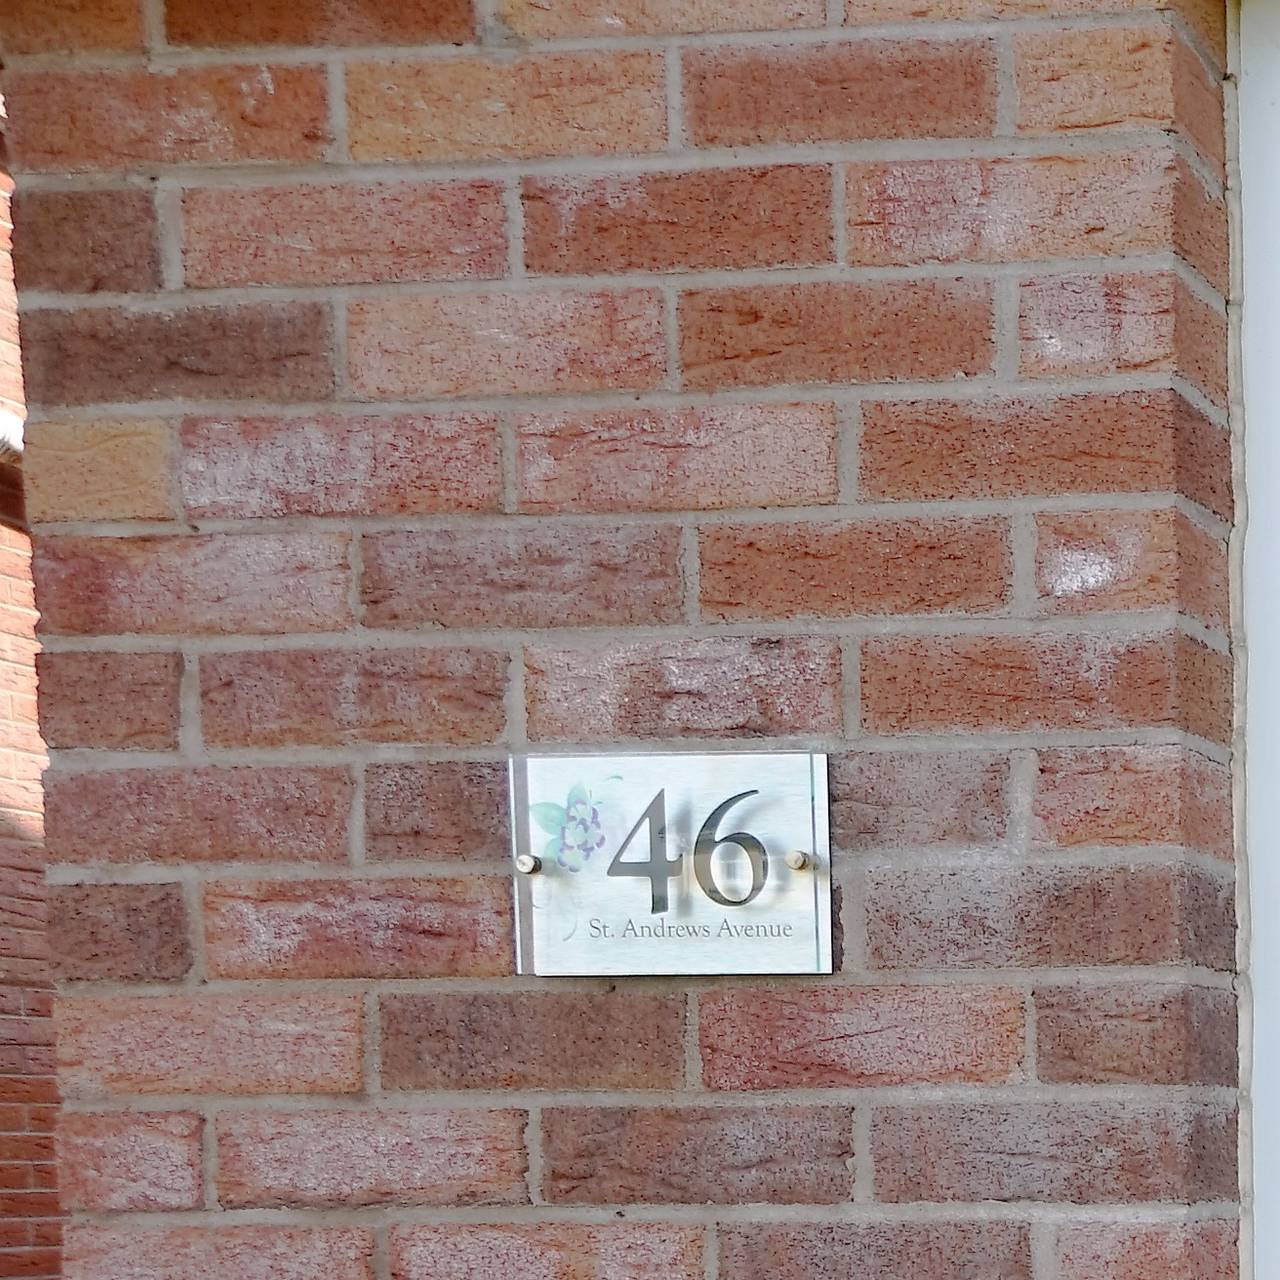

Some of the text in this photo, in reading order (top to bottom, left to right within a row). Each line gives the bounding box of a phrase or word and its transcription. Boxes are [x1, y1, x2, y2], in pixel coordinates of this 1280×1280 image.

[606, 788, 769, 915] 46
[589, 918, 793, 938] St. Andrews Avenue
